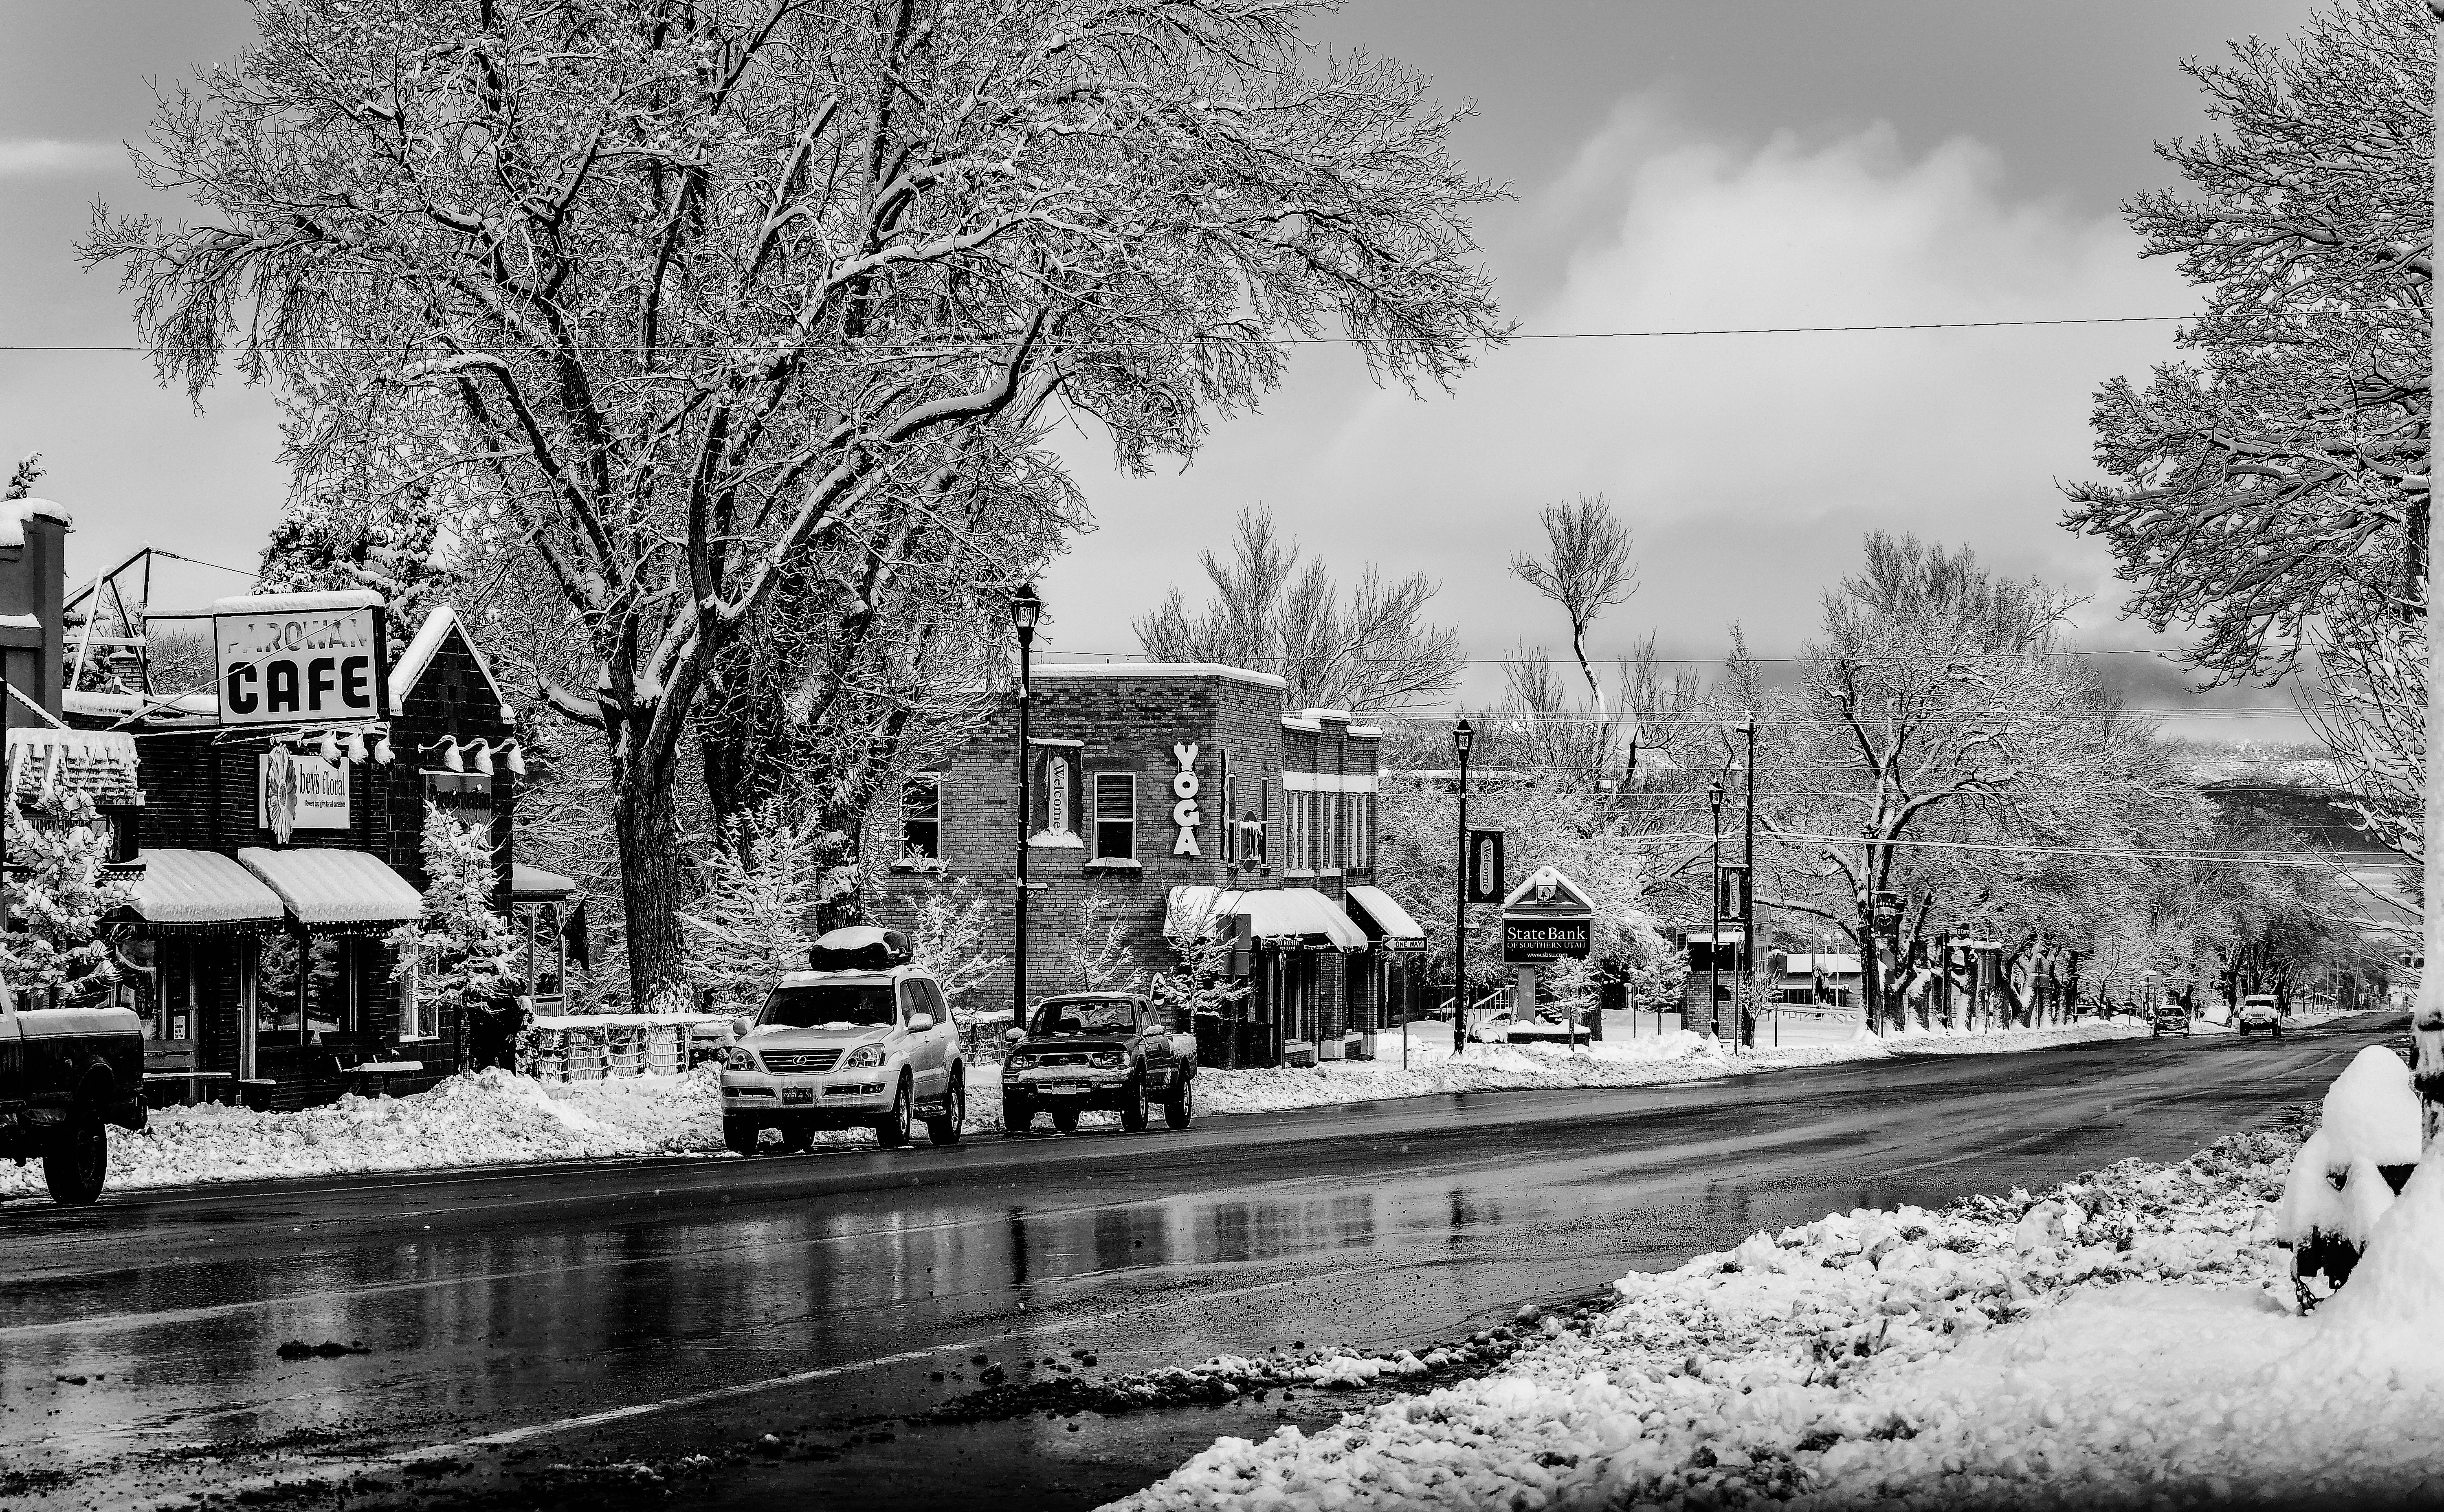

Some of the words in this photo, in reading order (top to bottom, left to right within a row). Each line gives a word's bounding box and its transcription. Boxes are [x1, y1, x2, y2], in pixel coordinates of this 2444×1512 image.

[227, 655, 371, 714] CAFE
[299, 763, 320, 795] bev's
[322, 770, 345, 796] floral
[1053, 764, 1065, 829] Welcome
[1174, 742, 1201, 855] YOGA
[1483, 844, 1492, 890] Welcome
[1508, 927, 1545, 940] State
